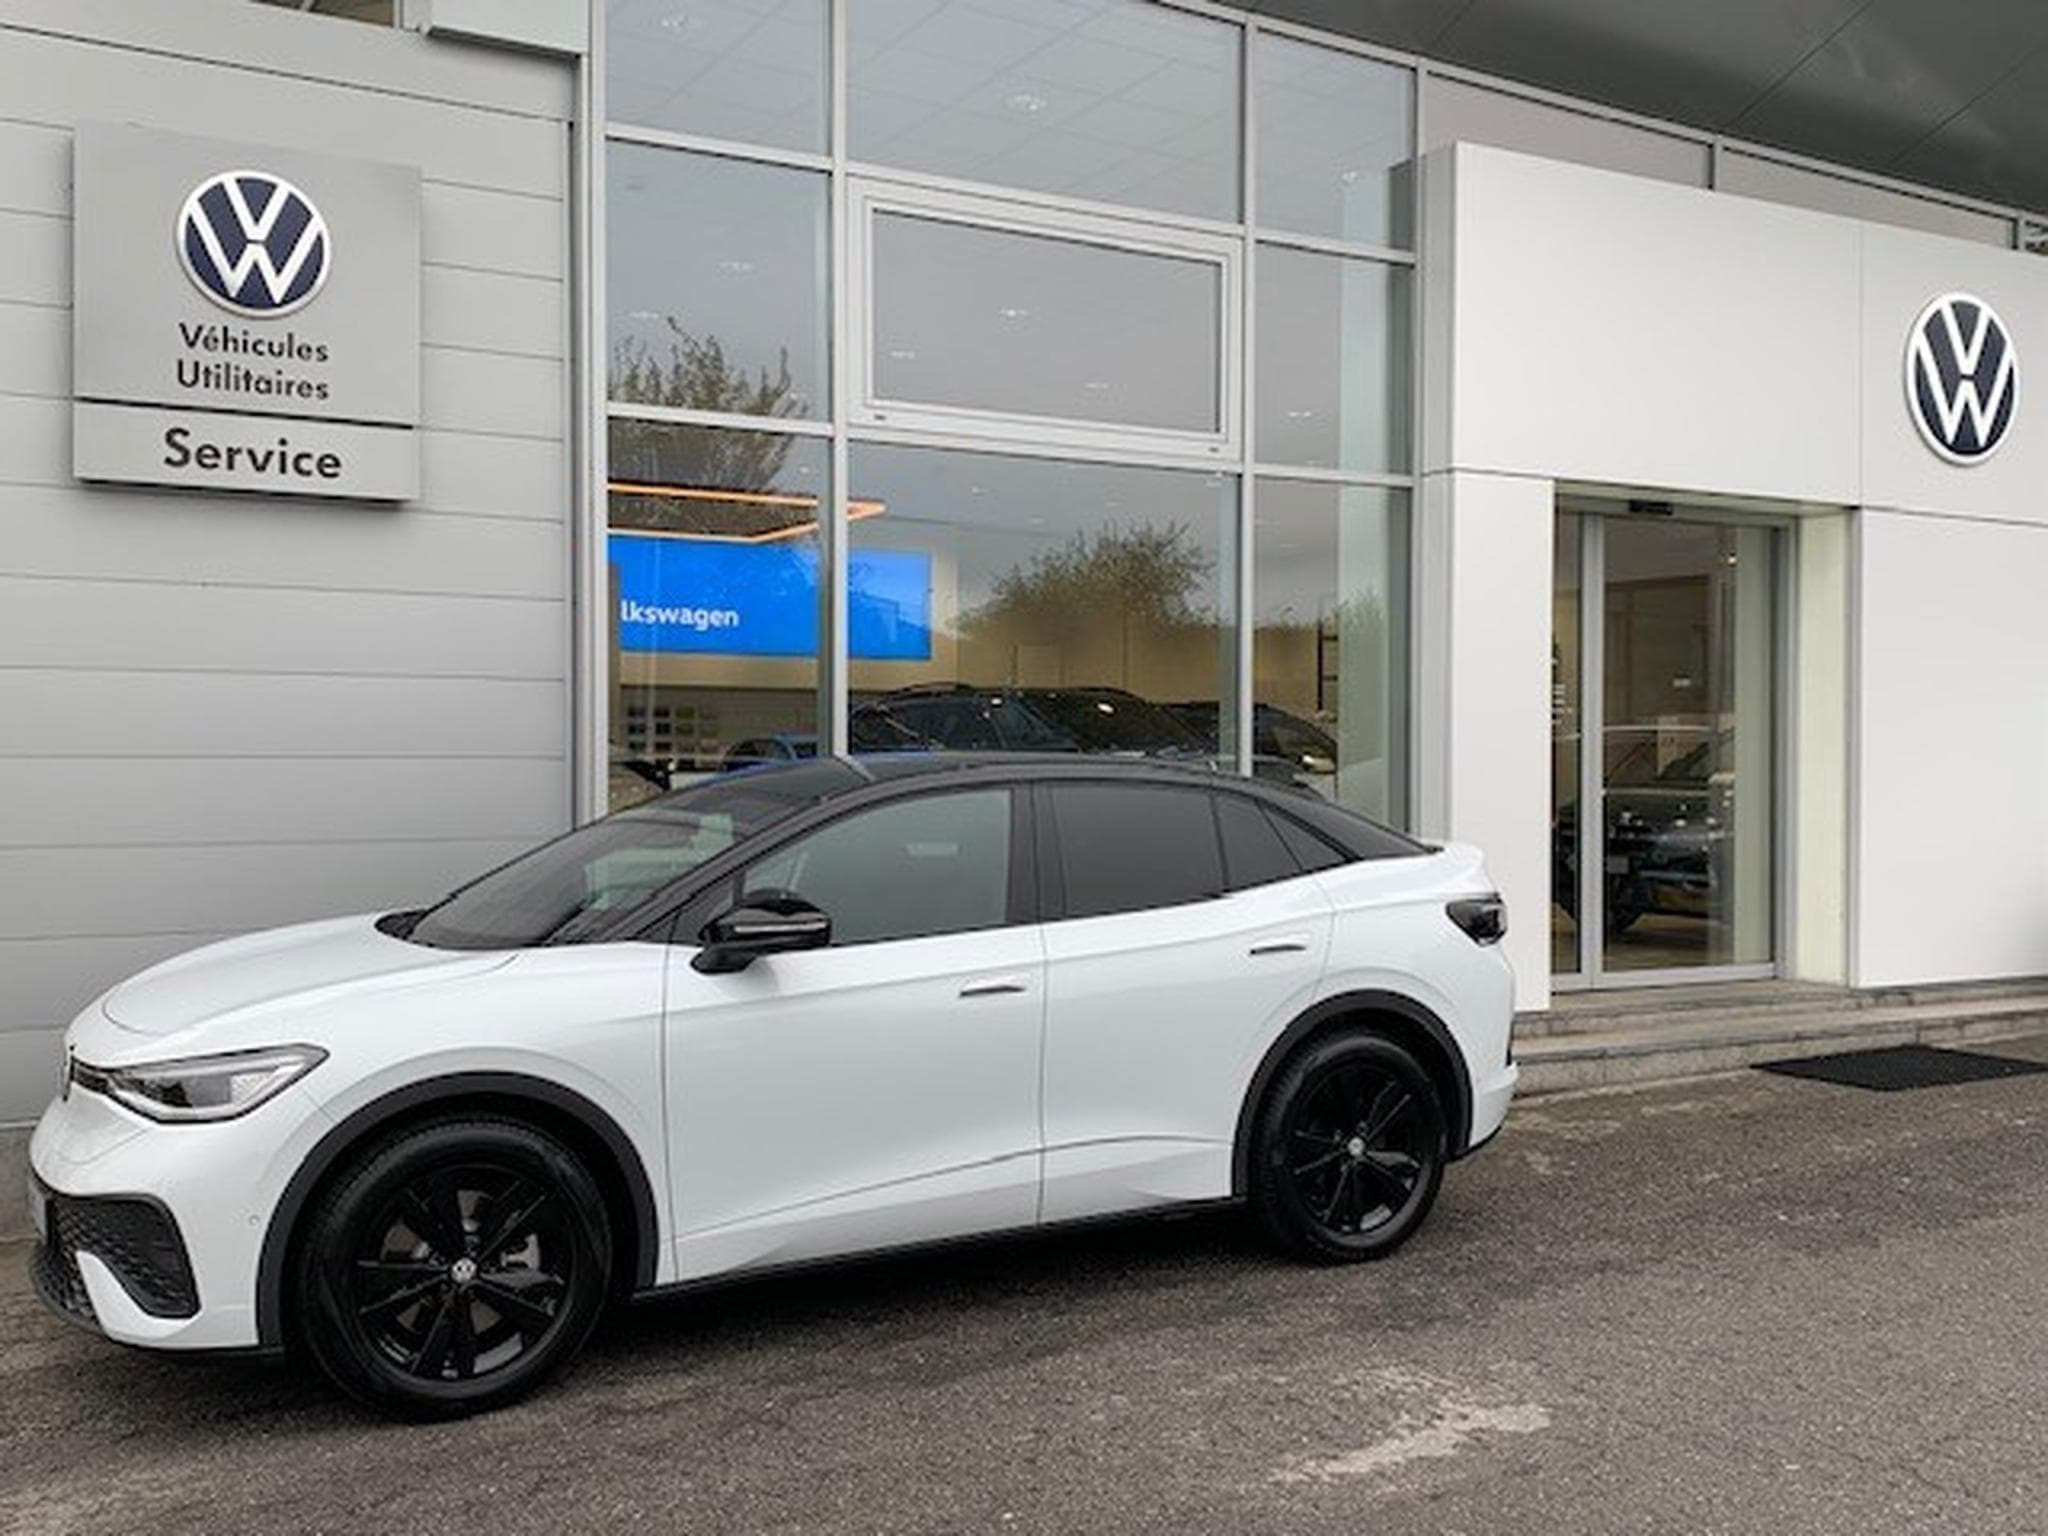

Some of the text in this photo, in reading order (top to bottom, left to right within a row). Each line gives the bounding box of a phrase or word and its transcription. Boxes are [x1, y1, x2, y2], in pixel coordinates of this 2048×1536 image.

[179, 322, 329, 362] Véhicules
[177, 359, 329, 400] Utilitaires
[164, 427, 342, 479] Service
[621, 600, 740, 631] lkswagen
